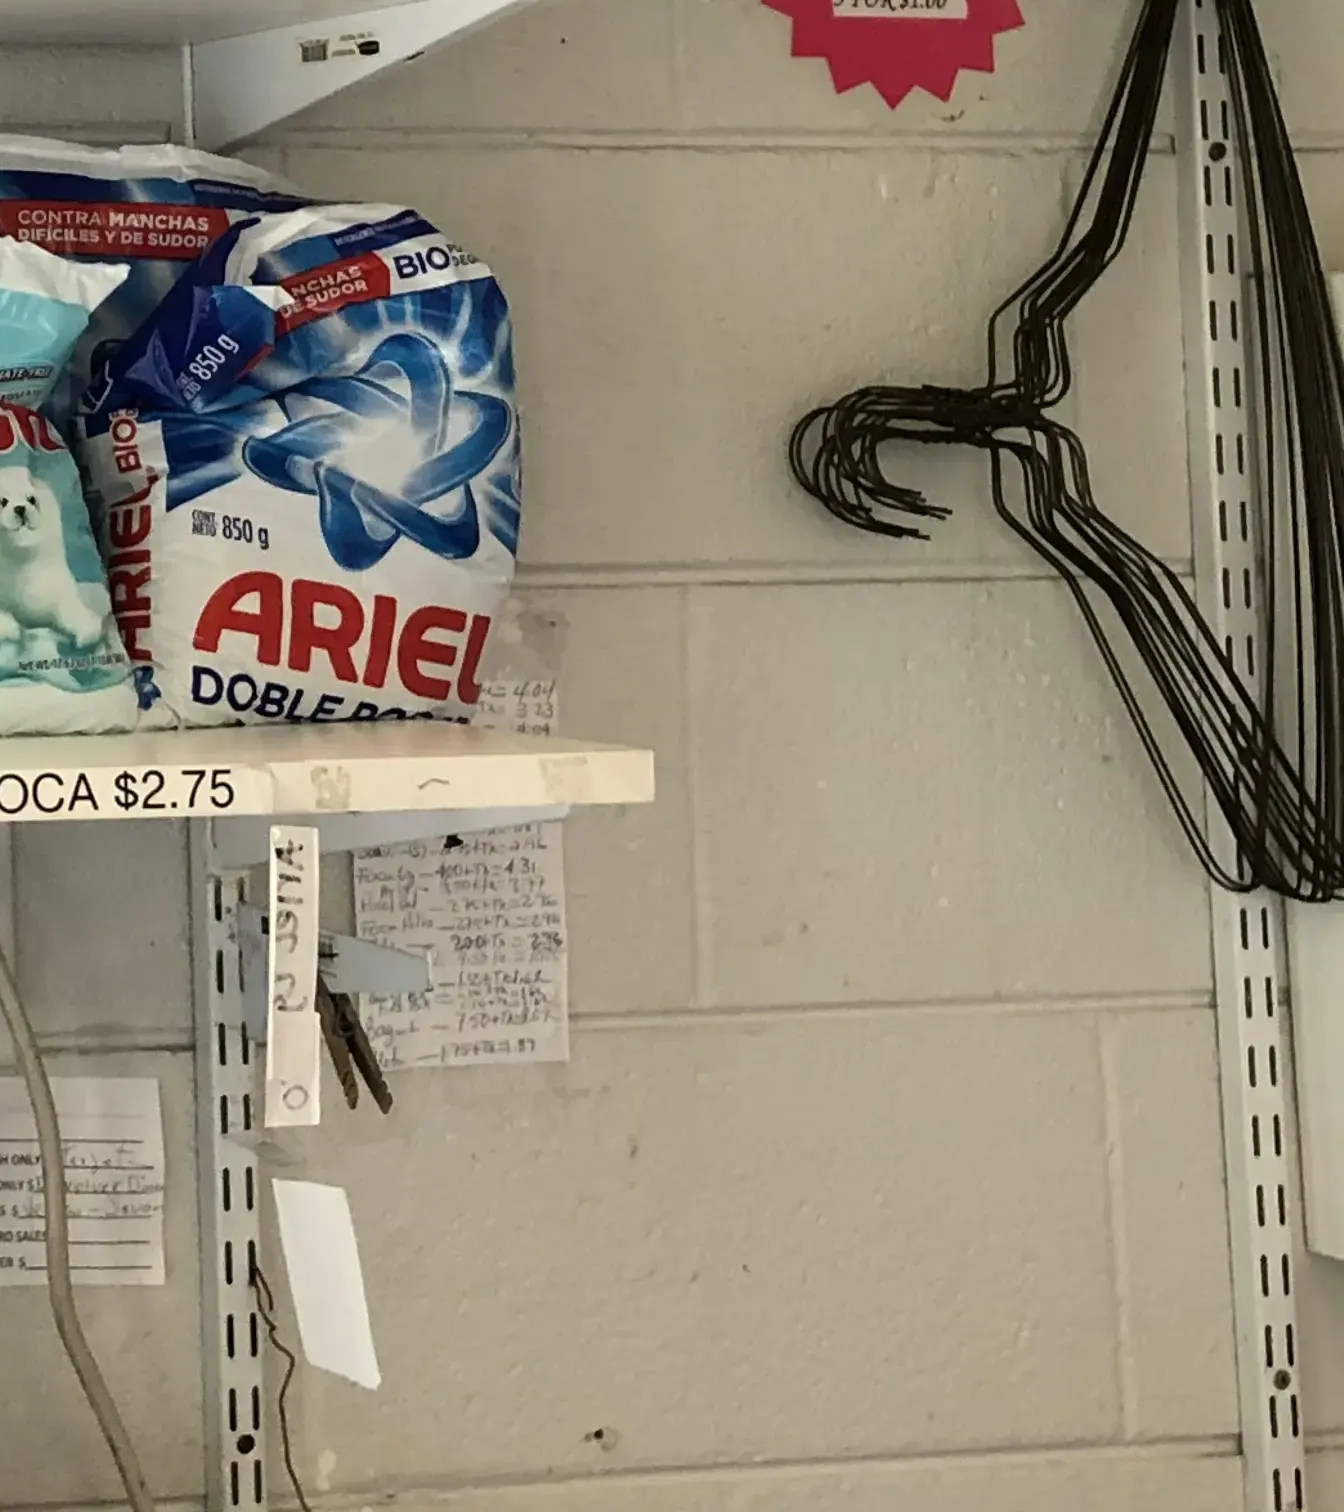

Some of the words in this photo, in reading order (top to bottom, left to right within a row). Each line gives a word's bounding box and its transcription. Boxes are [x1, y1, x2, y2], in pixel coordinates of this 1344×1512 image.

[18, 210, 103, 228] CONTRA
[109, 212, 209, 232] MANCHAS
[121, 229, 144, 245] DE
[148, 231, 208, 248] SUDOR
[223, 515, 253, 543] 850
[193, 571, 491, 704] ARIEL
[114, 768, 235, 811] $2.75
